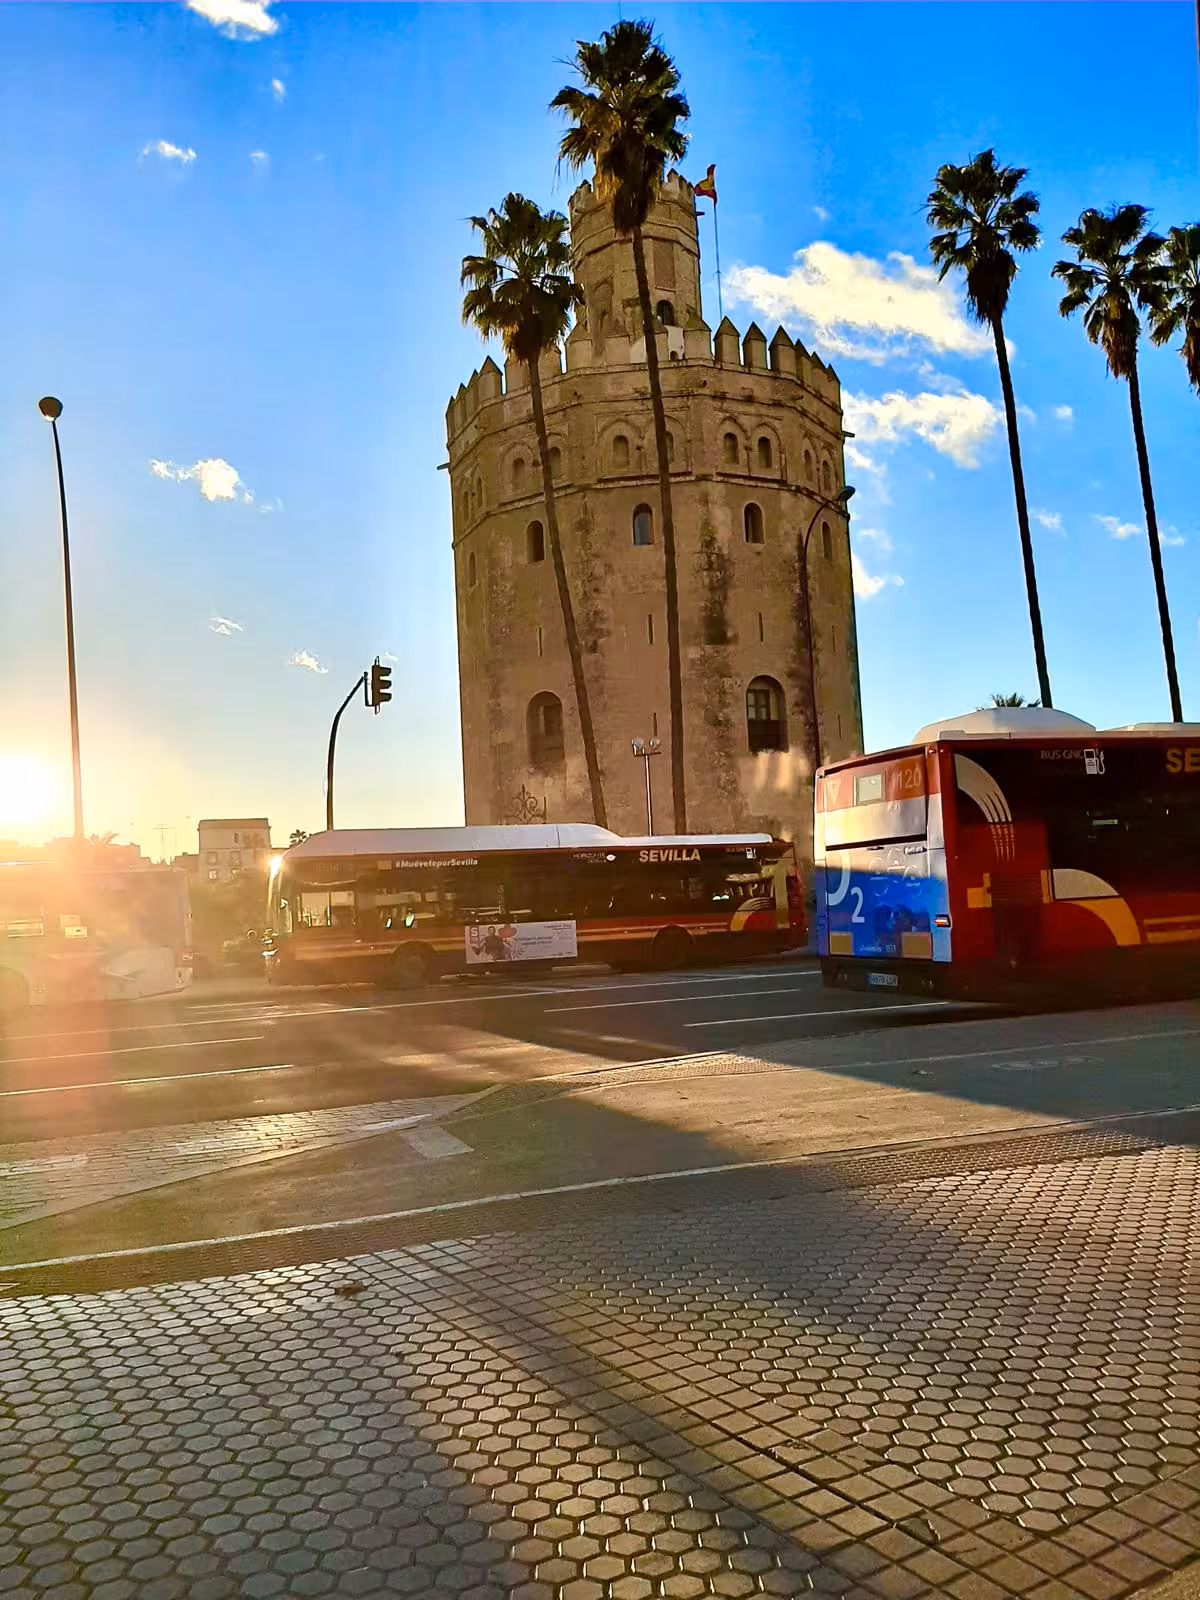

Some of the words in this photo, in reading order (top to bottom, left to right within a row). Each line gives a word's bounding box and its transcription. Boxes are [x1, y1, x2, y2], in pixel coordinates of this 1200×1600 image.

[1040, 749, 1062, 760] BUS
[1166, 748, 1200, 773] SE
[639, 848, 701, 862] SEVILLA
